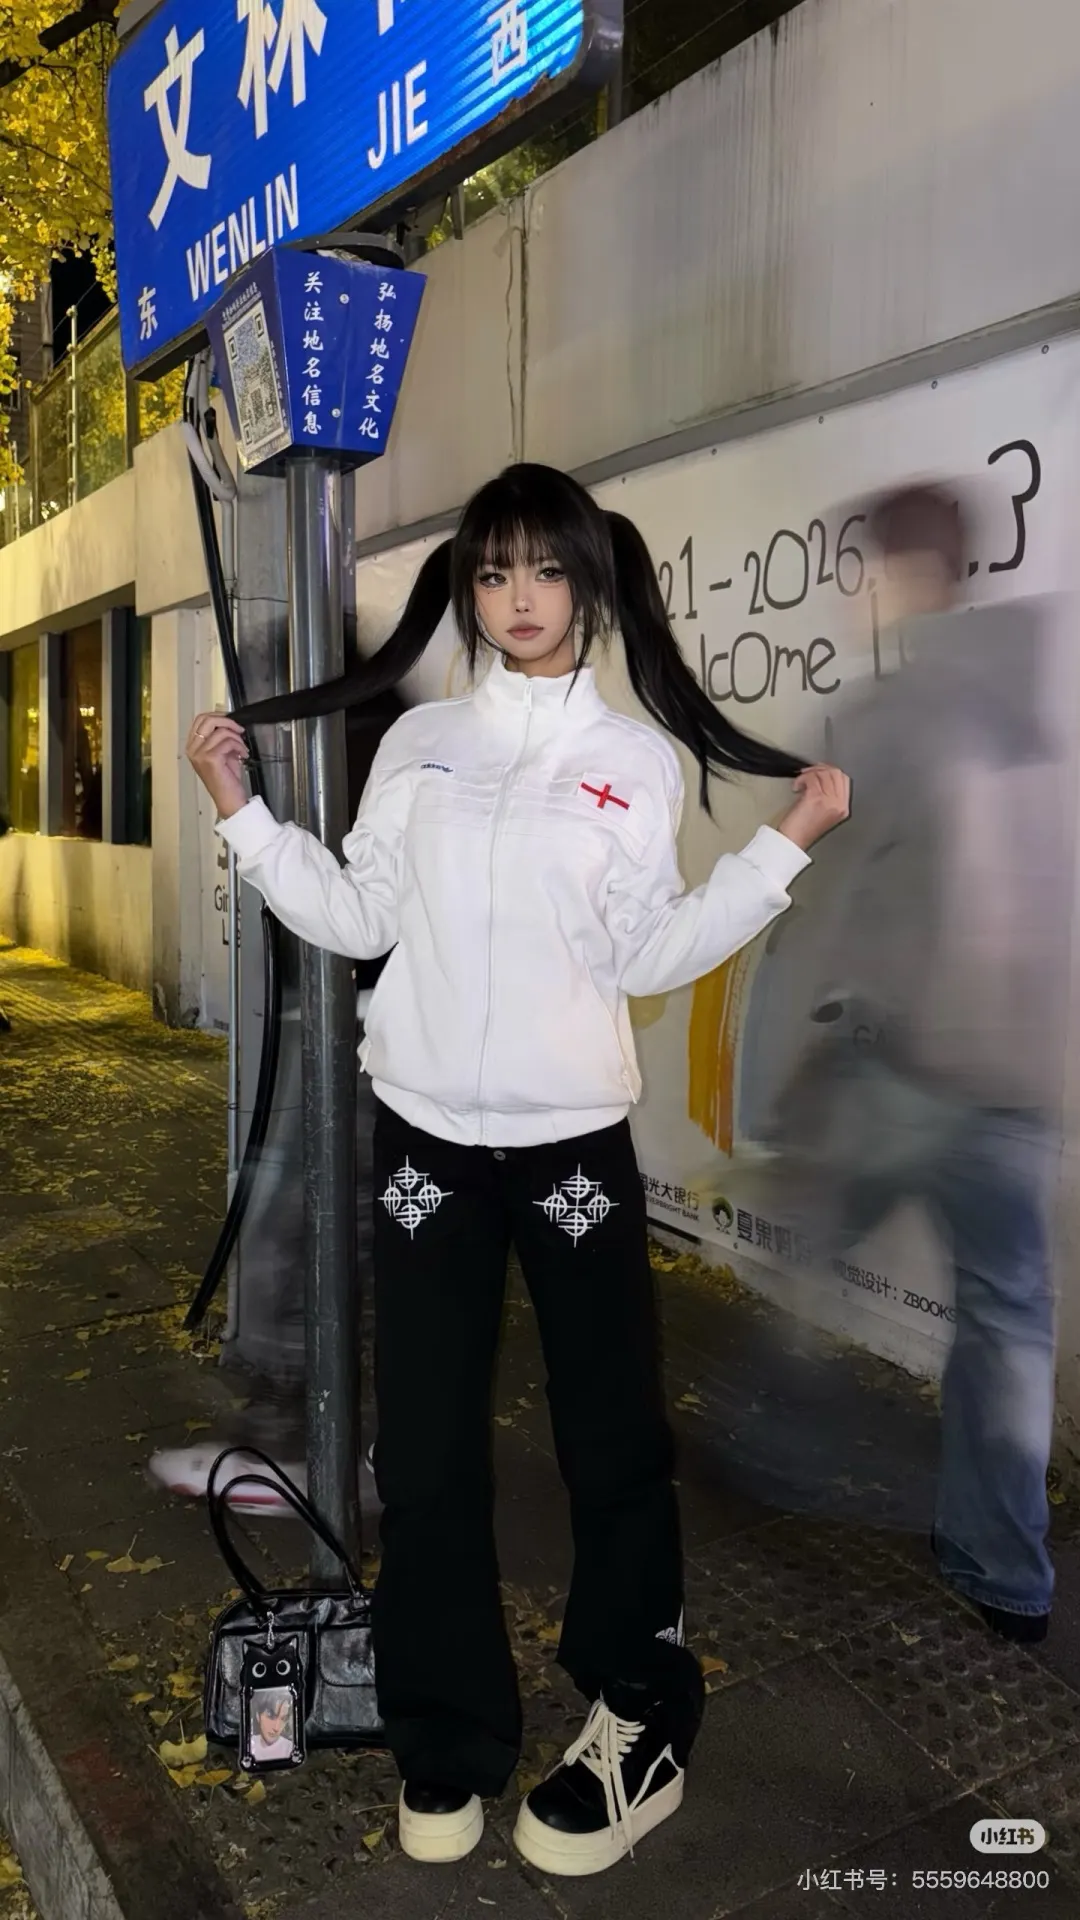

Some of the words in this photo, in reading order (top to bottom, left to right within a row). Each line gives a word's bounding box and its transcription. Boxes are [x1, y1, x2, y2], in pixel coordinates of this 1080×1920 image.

[487, 0, 529, 87] 西
[186, 163, 299, 303] WENLIN
[368, 60, 428, 170] JIE
[137, 286, 159, 341] 东
[302, 271, 325, 435] 关注地名信息
[358, 282, 397, 439] 弘扬地名文化
